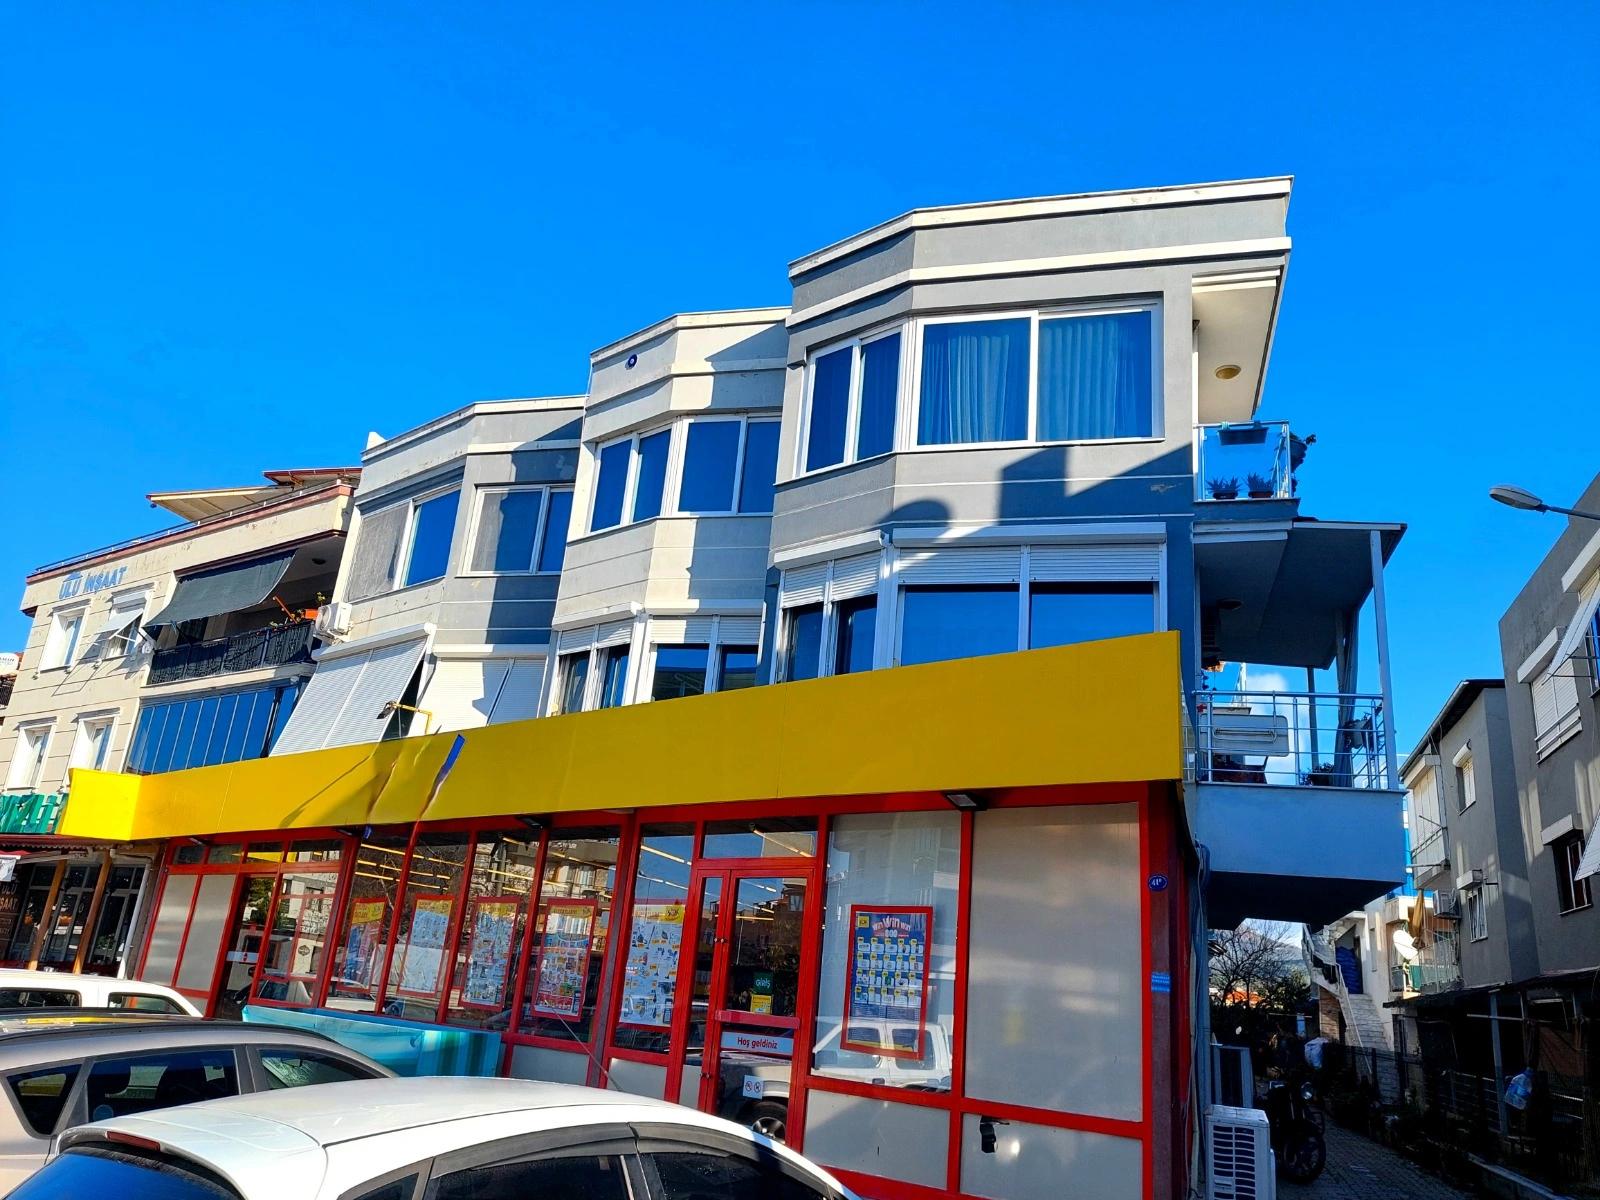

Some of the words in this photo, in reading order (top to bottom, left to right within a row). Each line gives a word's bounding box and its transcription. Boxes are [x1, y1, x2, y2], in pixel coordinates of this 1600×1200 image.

[59, 577, 80, 600] ULU
[737, 1036, 750, 1048] Hoş
[751, 1038, 778, 1050] geldiniz
